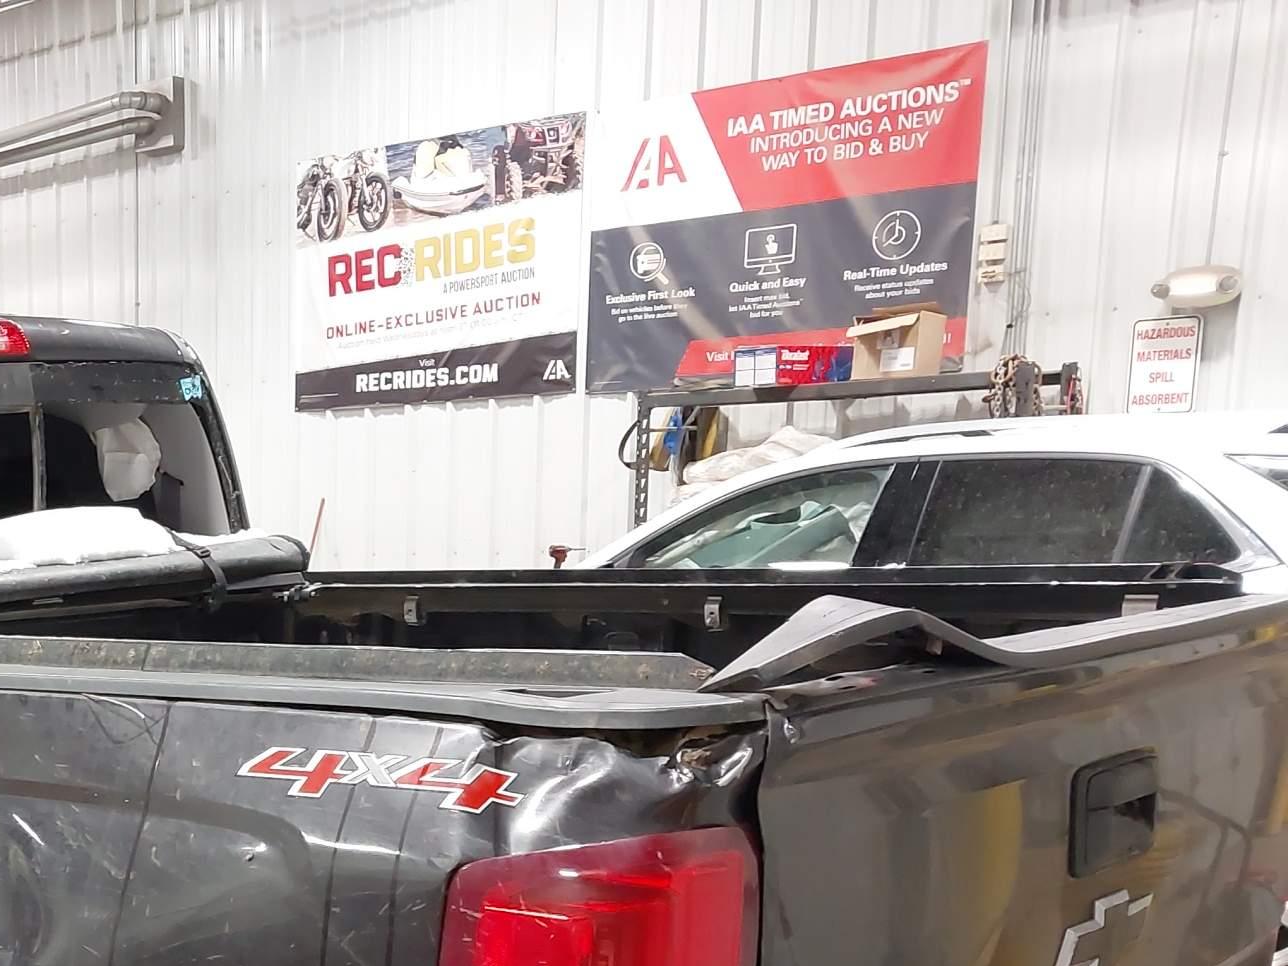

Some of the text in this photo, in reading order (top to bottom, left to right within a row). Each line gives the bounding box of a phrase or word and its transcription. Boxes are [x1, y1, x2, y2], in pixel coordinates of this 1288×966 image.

[727, 114, 765, 137] IAA
[770, 102, 834, 130] TIMED
[750, 108, 944, 153] INTRODUCING A NEW
[762, 131, 929, 172] WAY TO BID & BUY
[328, 217, 535, 297] REC RIDES
[443, 267, 535, 294] A POWERSPORT AUCTION
[843, 262, 948, 281] Real-Time Updates
[729, 277, 807, 292] Quick and Easy
[605, 286, 696, 304] Exclusive First Look
[326, 304, 468, 339] ONLINE-EXCLUSIVE
[473, 291, 541, 315] AUCTION
[1136, 325, 1196, 341] HAZARDOUS
[418, 358, 435, 368] Visit
[706, 351, 729, 363] Visit
[1136, 348, 1192, 362] MATERIALS
[355, 363, 499, 393] RECRIDES.COM
[1148, 371, 1175, 384] SPILL
[1131, 392, 1190, 406] ABSORBENT
